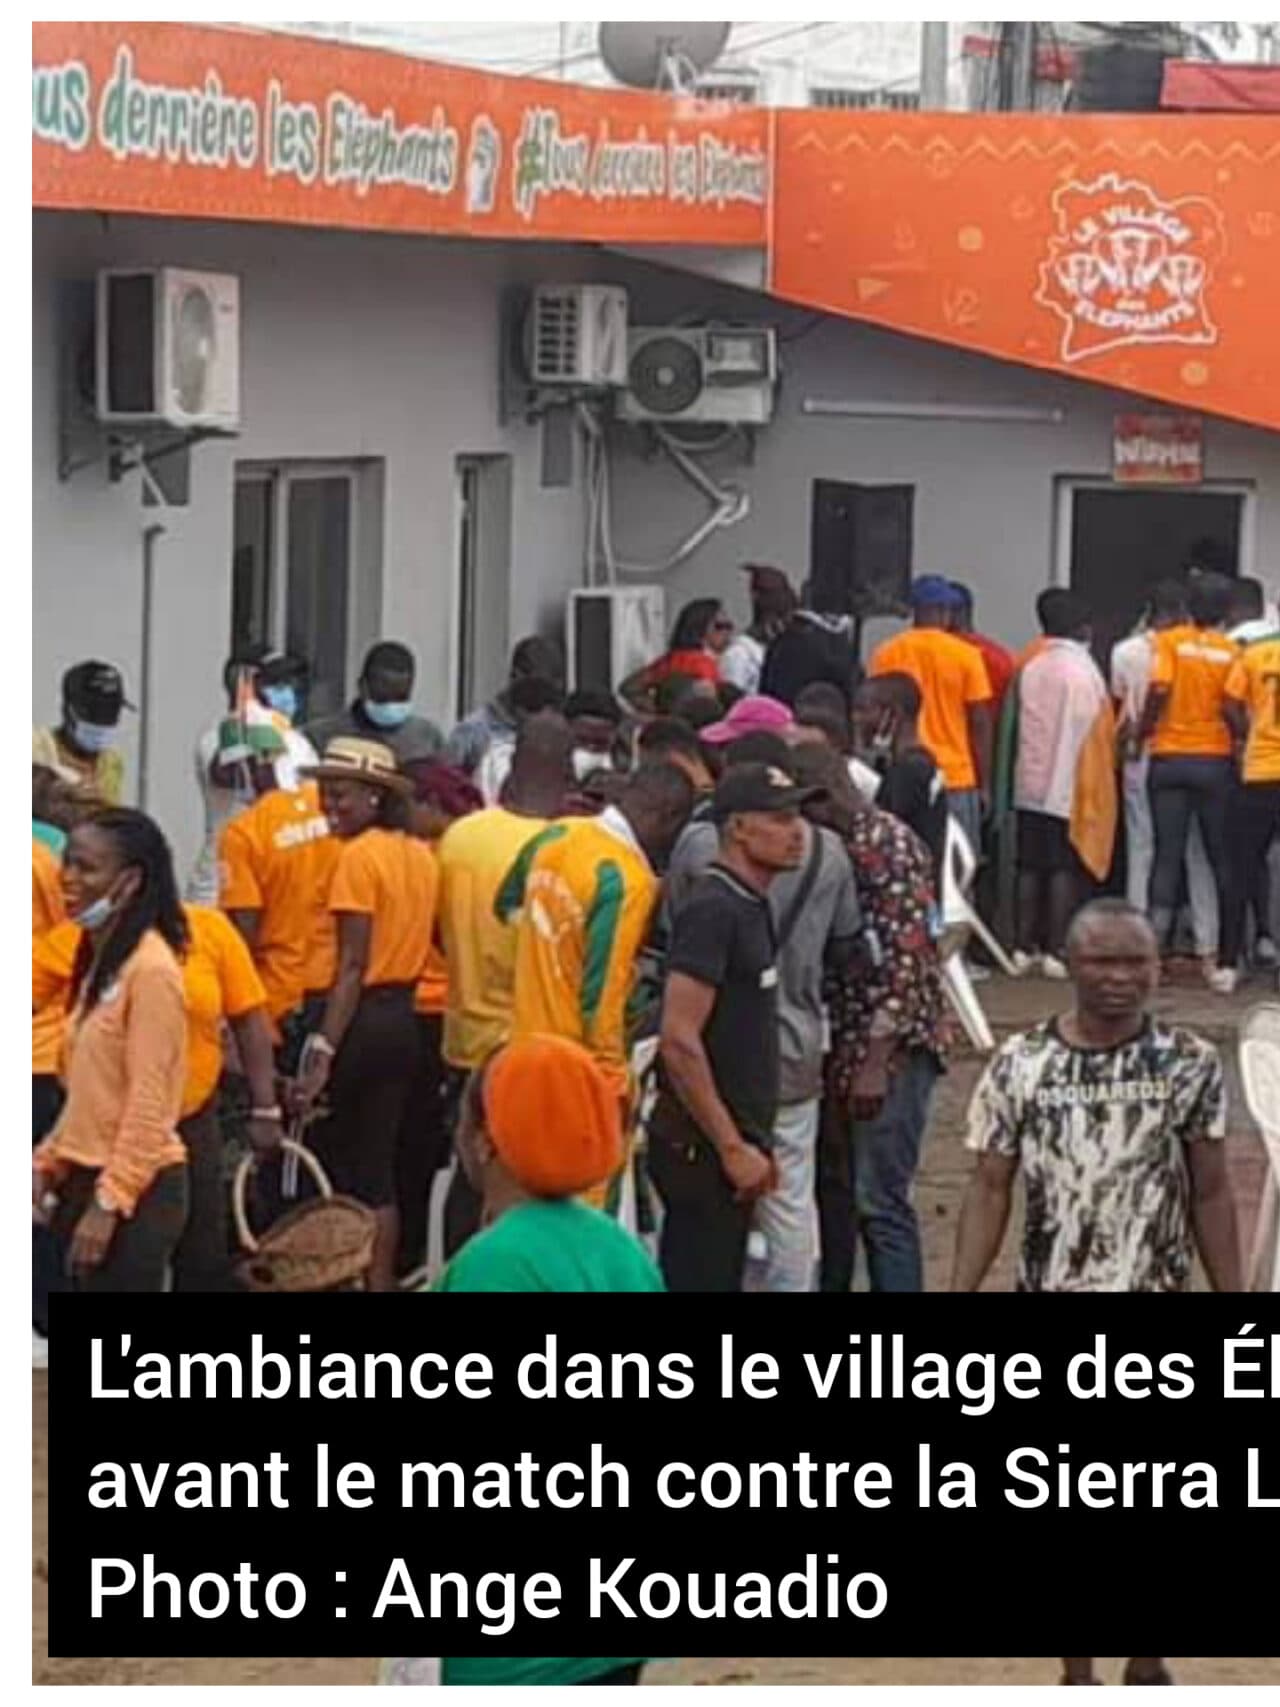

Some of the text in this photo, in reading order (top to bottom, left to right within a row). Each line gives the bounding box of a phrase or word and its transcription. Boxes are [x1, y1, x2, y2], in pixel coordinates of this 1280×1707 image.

[101, 45, 256, 166] derrière
[267, 79, 318, 183] les
[1102, 204, 1192, 245] VILLAGE
